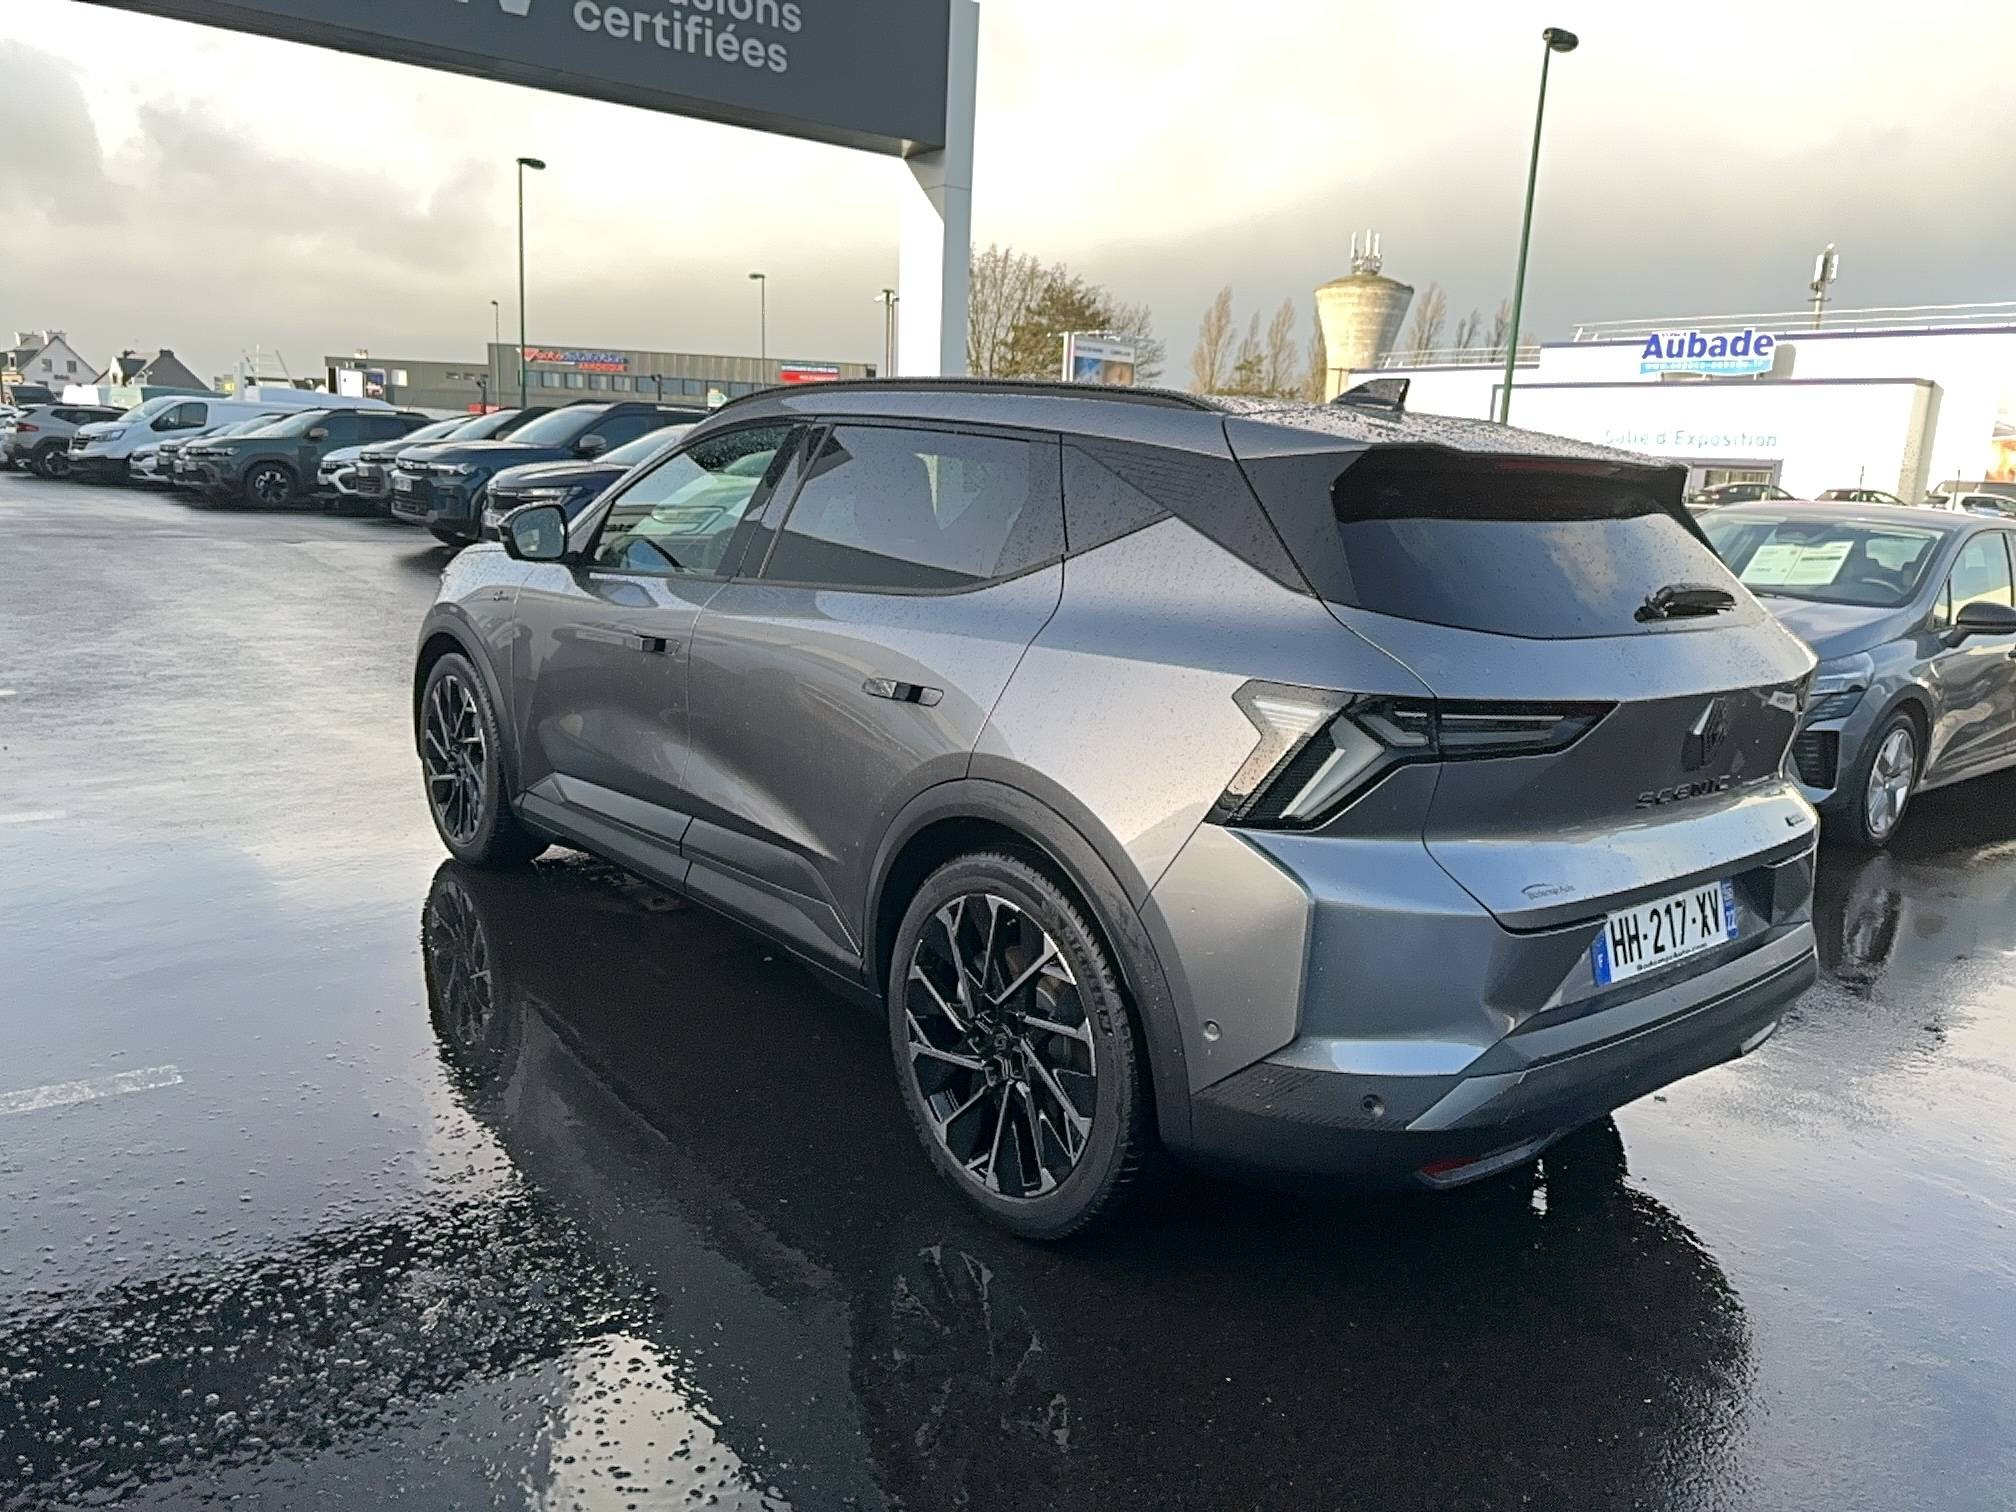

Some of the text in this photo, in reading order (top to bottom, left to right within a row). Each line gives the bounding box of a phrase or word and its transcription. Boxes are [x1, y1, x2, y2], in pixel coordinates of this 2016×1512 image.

[573, 0, 788, 73] certifiées
[1641, 329, 1774, 360] Aubade
[1610, 889, 1720, 968] HH-217-XV
